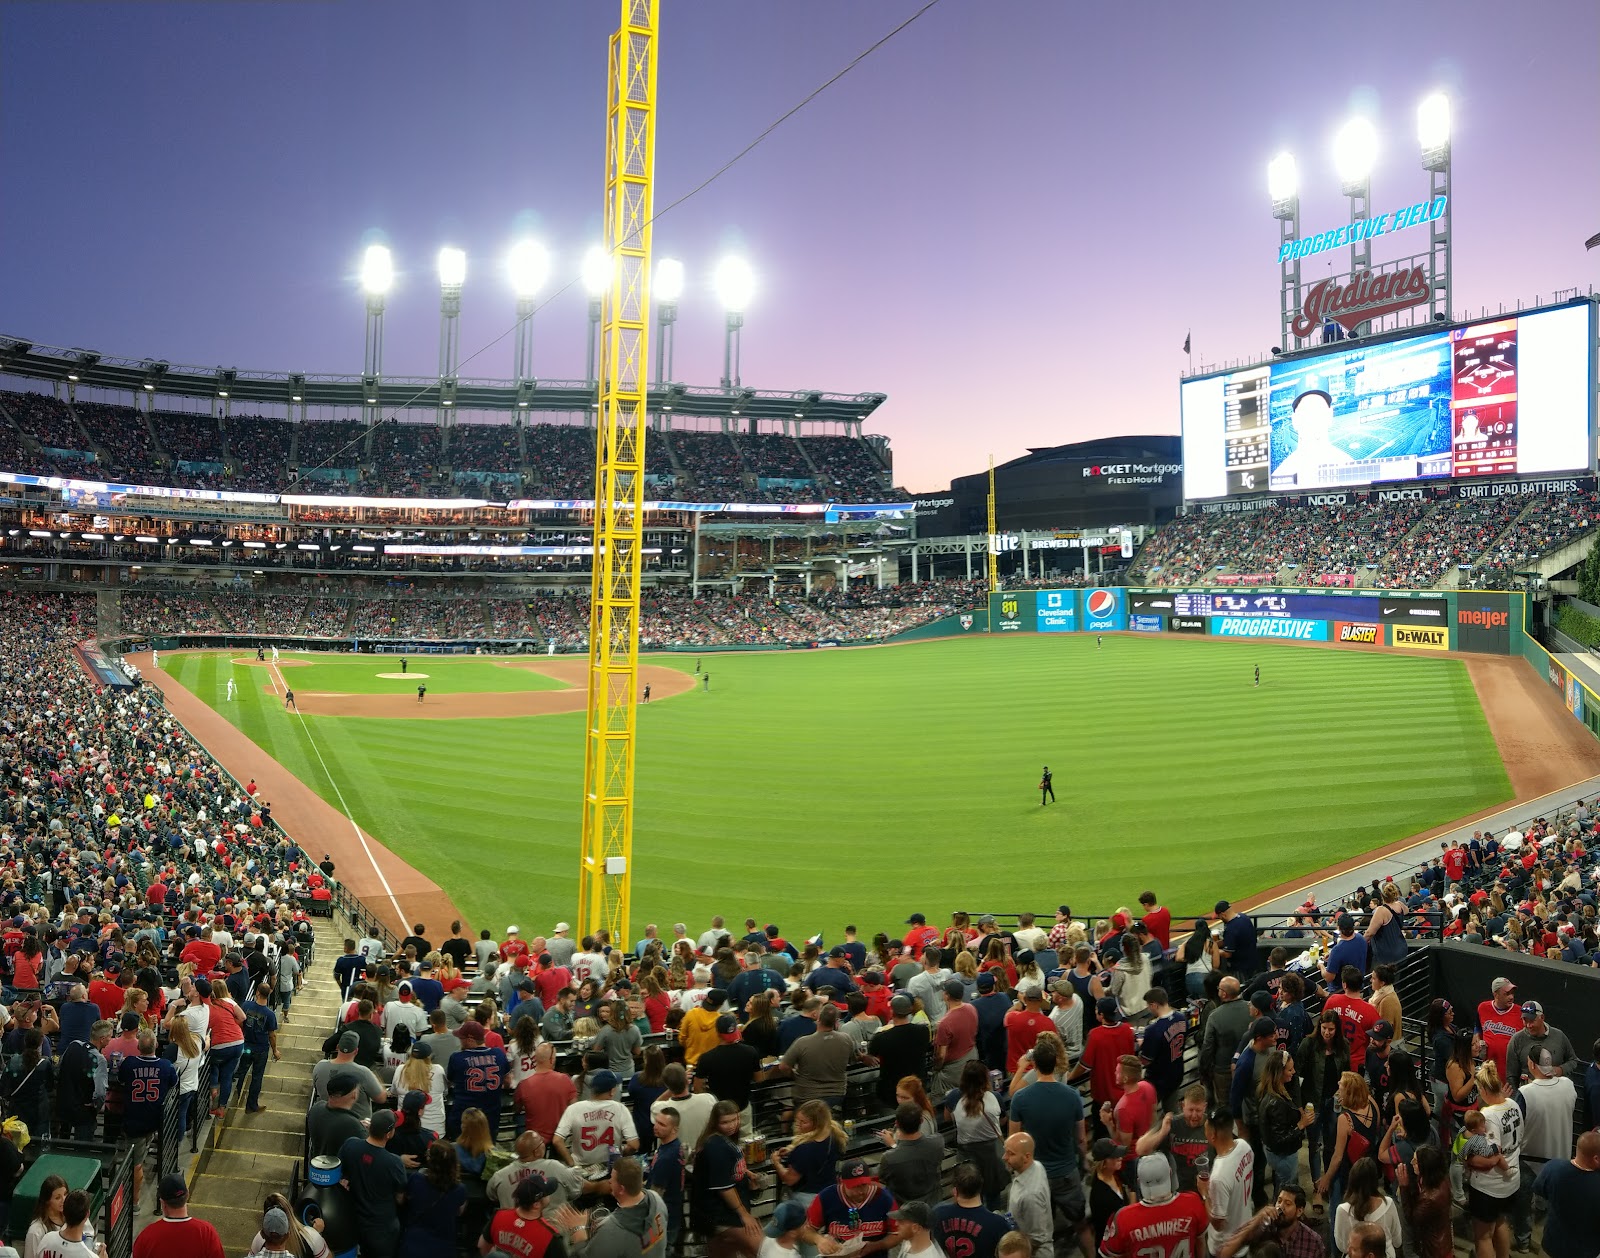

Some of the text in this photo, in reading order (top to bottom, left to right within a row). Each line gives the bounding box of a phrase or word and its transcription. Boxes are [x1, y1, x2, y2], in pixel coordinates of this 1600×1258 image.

[1278, 195, 1447, 264] PROGRESSIVE FIELD
[1292, 262, 1430, 338] Indians
[1083, 463, 1183, 477] ROCKET Mortgage
[1108, 476, 1163, 485] FIELDHOUSE
[1378, 490, 1423, 502] NOCO
[1460, 485, 1490, 498] START
[1491, 483, 1518, 496] DEAD
[918, 498, 954, 508] Mortgage
[1308, 494, 1347, 506] NOCO
[1202, 503, 1223, 514] START
[1223, 503, 1241, 511] DEAD
[988, 534, 1019, 556] Lite
[1032, 537, 1104, 549] BREWED IN OHIO
[1001, 600, 1018, 613] 811
[1038, 608, 1074, 617] Cleveland
[1045, 617, 1067, 625] Clinic
[1089, 620, 1113, 630] pepsi
[1458, 607, 1508, 629] meijer
[1219, 618, 1316, 639] PROGRESSIVE
[361, 945, 370, 957] 9
[576, 967, 592, 981] 12
[1345, 1008, 1364, 1023] SMILE
[1483, 1020, 1517, 1037] Indians
[132, 1067, 161, 1079] THOME
[465, 1066, 501, 1092] 25
[132, 1079, 161, 1102] 25
[498, 1230, 534, 1257] BIEBER
